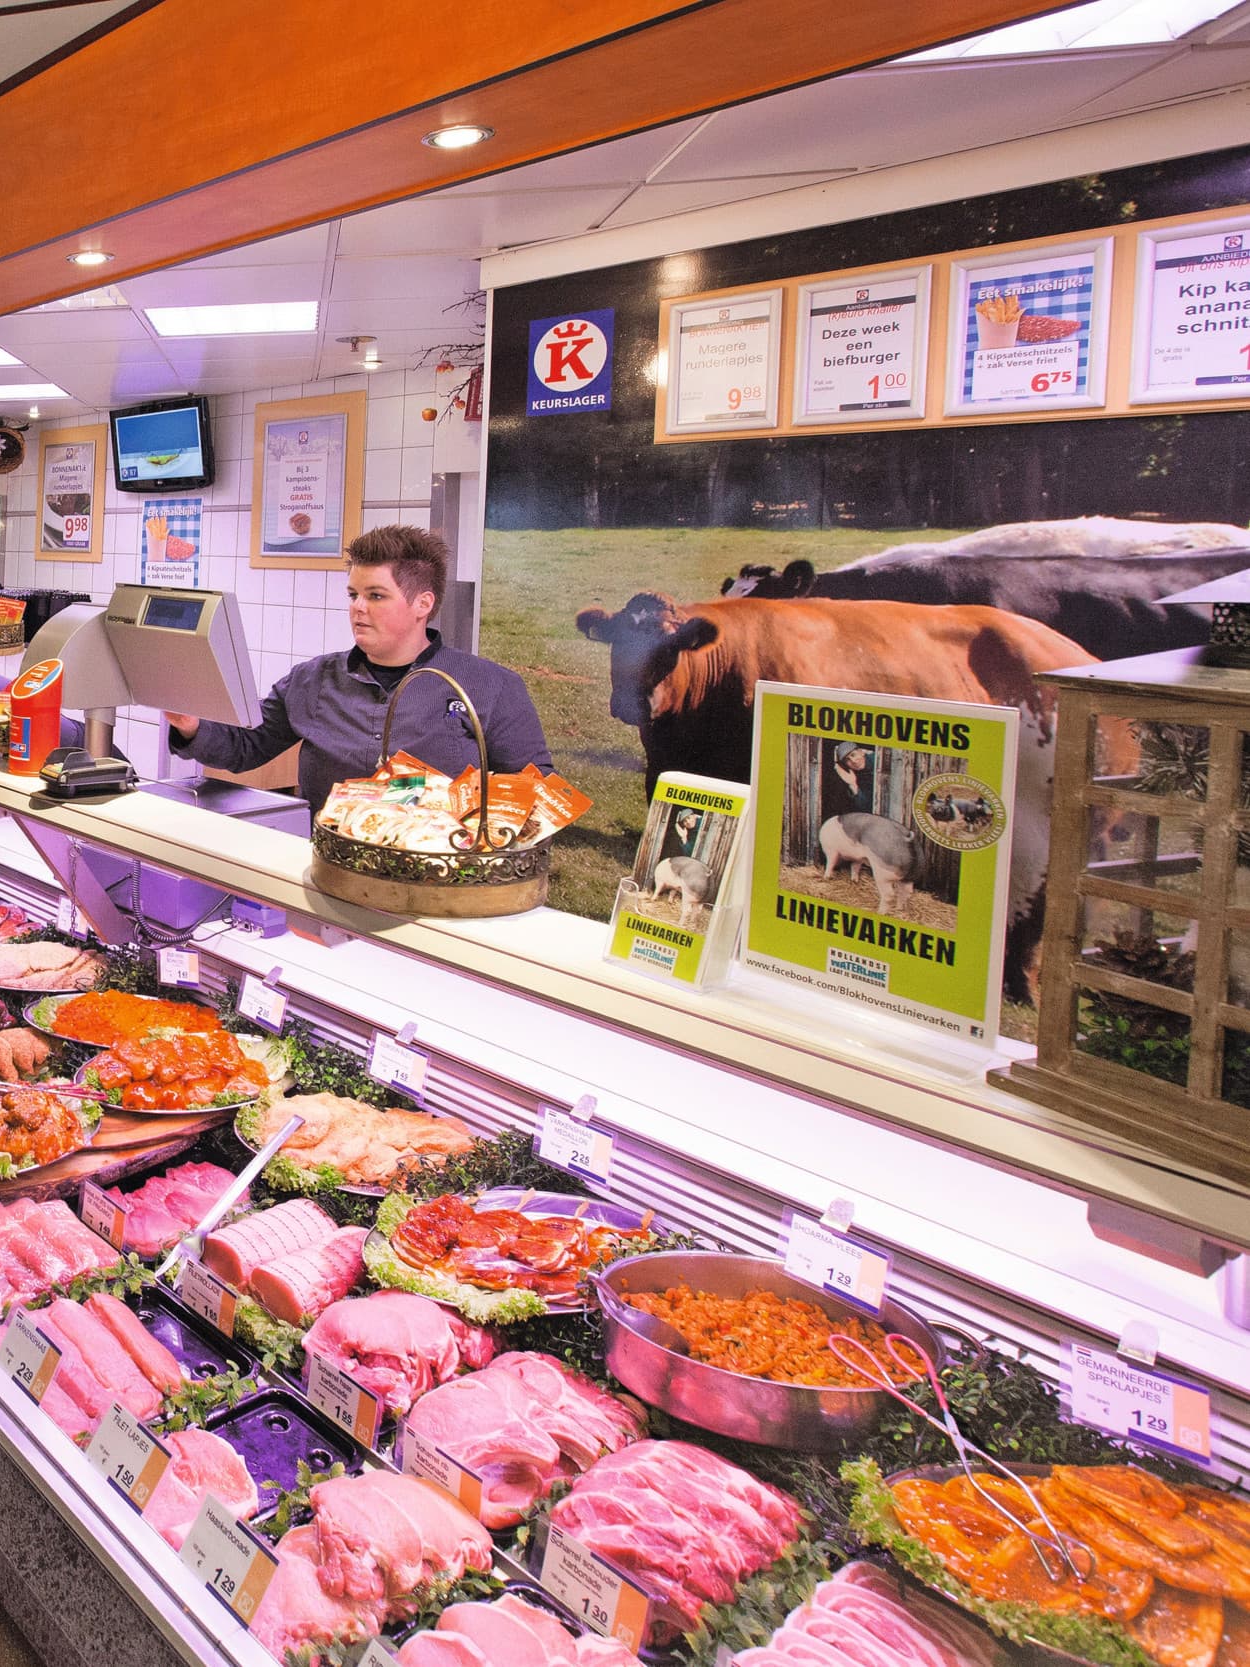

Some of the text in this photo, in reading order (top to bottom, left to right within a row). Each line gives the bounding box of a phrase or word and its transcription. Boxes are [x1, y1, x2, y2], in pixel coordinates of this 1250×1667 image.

[978, 276, 1084, 300] Eet smakelijk!
[1179, 284, 1216, 298] Kip
[822, 321, 900, 340] Deze week
[1176, 316, 1250, 334] schnit
[698, 342, 747, 355] Magere
[846, 341, 872, 351] een
[986, 346, 1073, 362] Kipsatéschnitzels
[544, 337, 594, 384] K
[686, 353, 764, 370] runderlapjes
[823, 352, 901, 368] biefburger
[1006, 359, 1033, 368] Verse
[1036, 356, 1058, 365] friet
[532, 394, 606, 410] KEURSLAGER
[292, 484, 311, 492] steaks
[280, 502, 324, 512] Stroganoffsaus
[788, 702, 970, 751] BLOKHOVENS
[666, 786, 734, 811] BLOKHOVENS
[626, 917, 694, 949] LINIEVARKEN
[776, 895, 956, 966] LINIEVARKEN
[830, 948, 887, 972] HOLLANDSE
[746, 958, 961, 1032] www.facebook.com/BlokhovensLinievarken
[318, 1362, 339, 1382] Scharrel
[1076, 1355, 1170, 1396] GEMARINEERDE
[320, 1375, 348, 1400] karbonade
[1088, 1370, 1162, 1404] SPEKLAPJES
[112, 1414, 150, 1453] FILET LAPJES
[416, 1452, 448, 1481] karbonade
[206, 1508, 250, 1557] Haaskarbonade
[550, 1534, 582, 1561] Scharrel
[582, 1558, 618, 1590] schouder
[562, 1555, 602, 1592] karbonade
